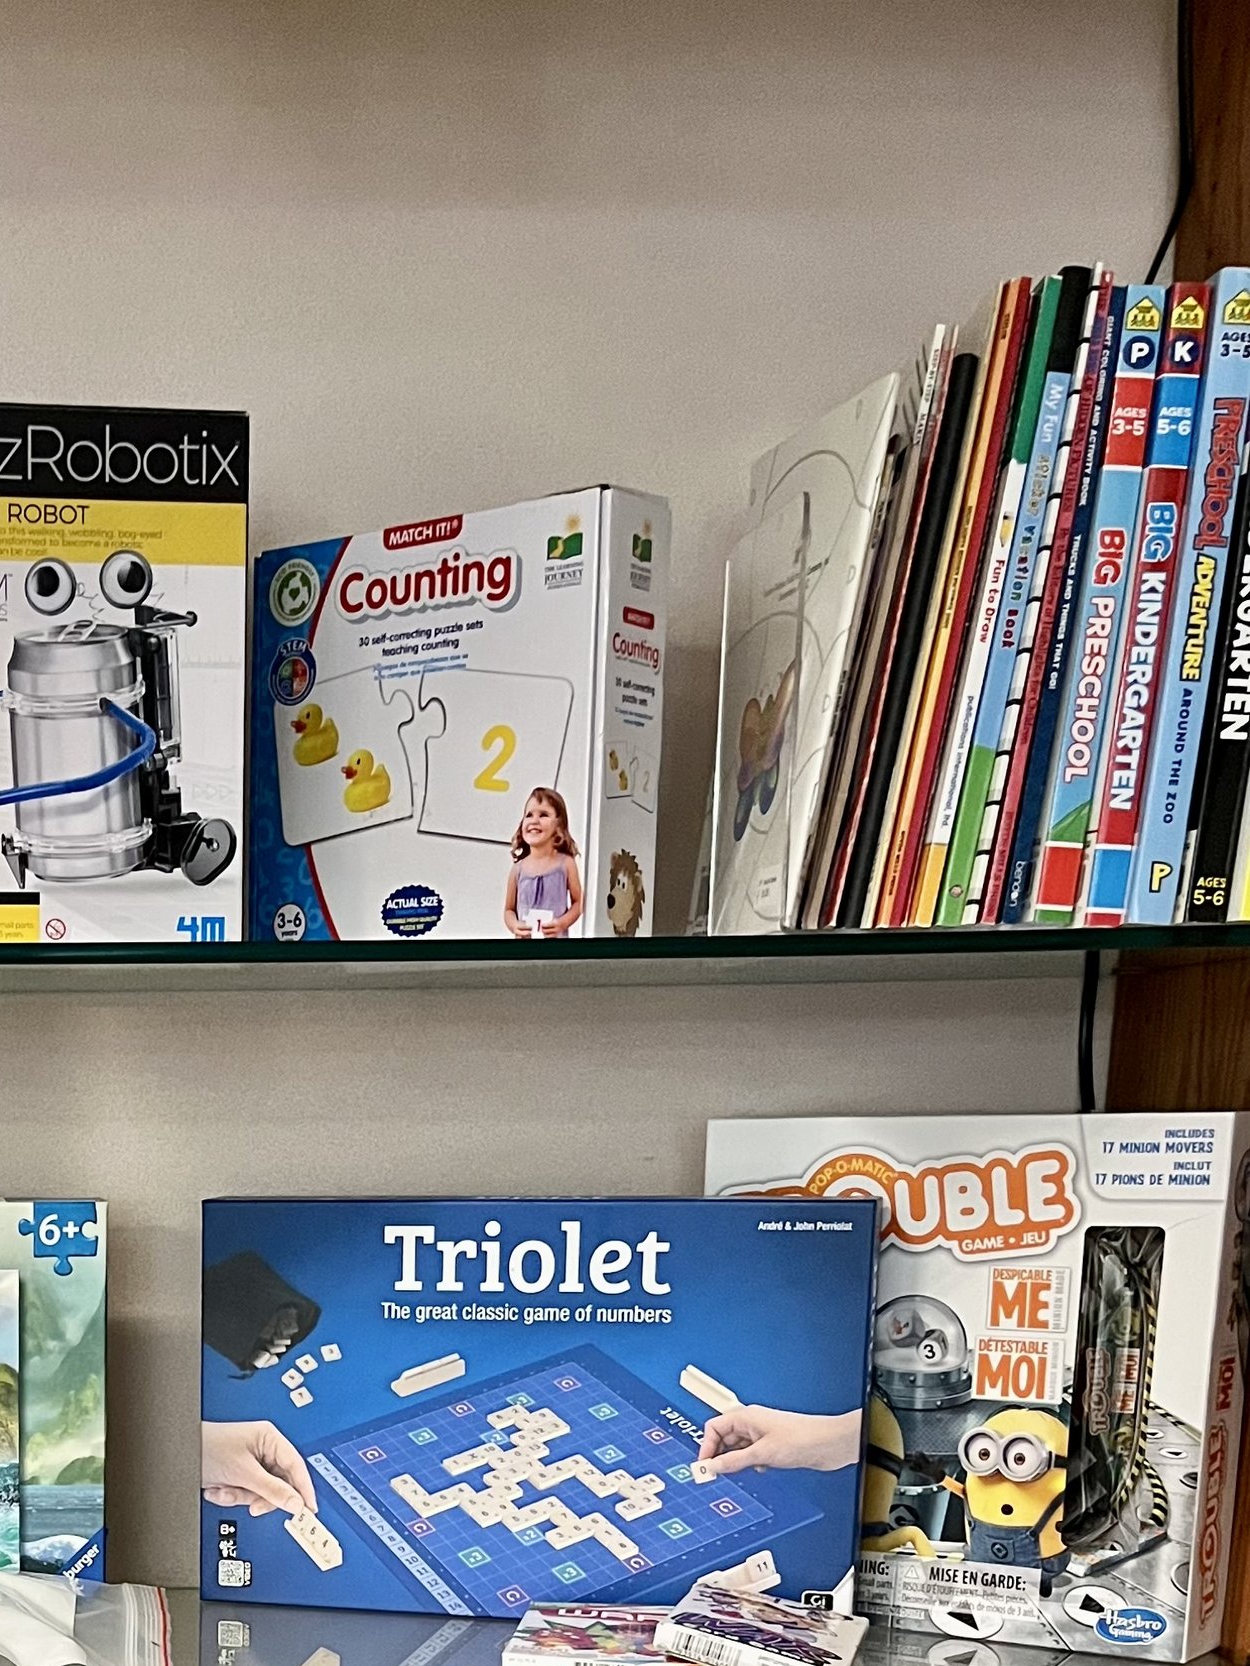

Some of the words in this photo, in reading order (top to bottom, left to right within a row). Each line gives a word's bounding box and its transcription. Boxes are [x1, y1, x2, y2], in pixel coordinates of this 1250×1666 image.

[1114, 408, 1147, 417] AGES
[1159, 408, 1191, 417] AGES
[1112, 420, 1145, 436] 3-5
[1156, 420, 1191, 436] 5-6
[1193, 398, 1246, 549] PRESCHOOL
[8, 503, 90, 524] ROBOT
[388, 526, 433, 546] MATCH
[435, 521, 451, 537] IT!
[1141, 502, 1178, 564] BIG
[1094, 528, 1127, 586] BIG
[340, 552, 512, 613] Counting
[990, 559, 1005, 585] Fun
[988, 587, 996, 603] to
[979, 607, 996, 644] Draw
[1181, 555, 1216, 680] ADVENTURE
[359, 636, 370, 647] 30
[372, 627, 432, 646] self-correcting
[434, 622, 464, 639] puzzle
[466, 620, 483, 630] sets
[382, 642, 419, 657] teaching
[421, 637, 459, 652] counting
[613, 633, 659, 669] Counting
[1064, 597, 1116, 784] PRESCHOOL
[1109, 571, 1166, 811] KINDERGARTEN
[1176, 688, 1192, 753] AROUND
[474, 724, 516, 792] 2
[1169, 758, 1182, 787] THE
[1163, 793, 1177, 824] ZOO
[1197, 877, 1226, 888] AGES
[387, 898, 417, 909] ACTUAL
[421, 896, 439, 907] SIZE
[1193, 889, 1224, 905] 5-6
[278, 912, 301, 929] 3-6
[1165, 1129, 1215, 1138] INCLUDES
[1103, 1142, 1114, 1153] 17
[1119, 1142, 1160, 1153] MINION
[1165, 1142, 1214, 1153] MOVERS
[809, 1158, 893, 1194] POP-O-MATIC
[1174, 1162, 1212, 1170] INCLUT
[1095, 1174, 1107, 1185] 17
[1112, 1174, 1144, 1185] PIONS
[1150, 1174, 1164, 1185] DE
[1168, 1174, 1210, 1185] MINION
[38, 1215, 80, 1245] 6+
[962, 1236, 1004, 1251] GAME
[1020, 1231, 1046, 1245] JEU
[383, 1220, 671, 1297] Triolet
[993, 1268, 1052, 1281] DESPICABLE
[381, 1303, 411, 1321] The
[415, 1303, 457, 1324] great
[462, 1303, 519, 1322] classic
[523, 1306, 570, 1324] game
[575, 1305, 593, 1322] of
[597, 1306, 672, 1324] numbers
[990, 1281, 1051, 1329] ME
[924, 1343, 936, 1359] 3
[978, 1338, 1048, 1354] DÉTESTABLE
[976, 1353, 1047, 1400] MOI
[929, 1566, 960, 1585] MISE
[963, 1570, 979, 1586] EN
[981, 1572, 1027, 1591] GARDE:
[1104, 1609, 1161, 1631] Hasbro
[1108, 1625, 1153, 1641] Gaming
